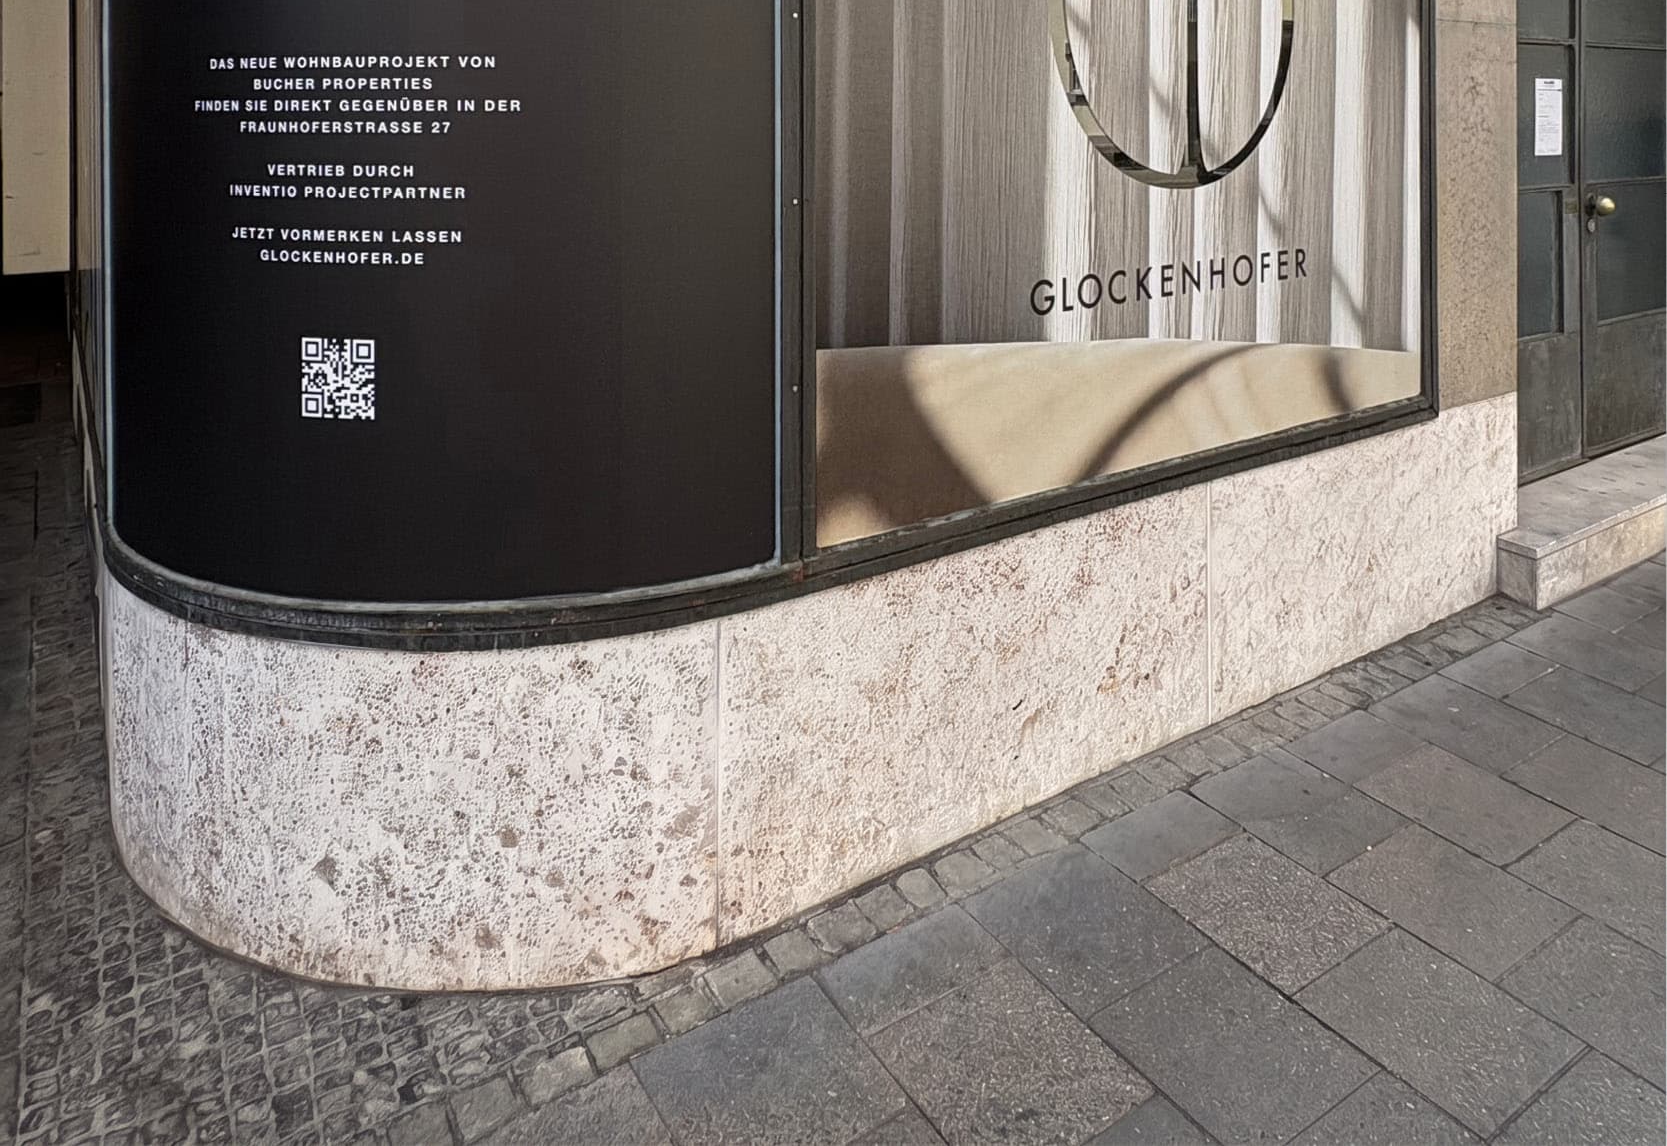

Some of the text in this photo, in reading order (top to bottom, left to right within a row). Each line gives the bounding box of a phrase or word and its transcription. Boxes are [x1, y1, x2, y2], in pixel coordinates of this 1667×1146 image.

[210, 56, 495, 69] DAS NEUE WOHNBAUPROJEKT VON
[254, 78, 432, 90] BUCHER PROPERTIES
[195, 97, 520, 111] FINDEN SIE DIREKT GEGENÜBER IN DER
[241, 121, 450, 133] FRAUNHOFERSTRASSE 27
[268, 164, 413, 177] VERTRIEB DURCH
[230, 185, 465, 199] INVENTIO PROJECTPARTNER
[232, 227, 461, 242] JETZT VORMERKEN LASSEN
[261, 249, 423, 264] GLOCKENHOFER.DE
[1030, 248, 1307, 316] GLOCKENHOFER
